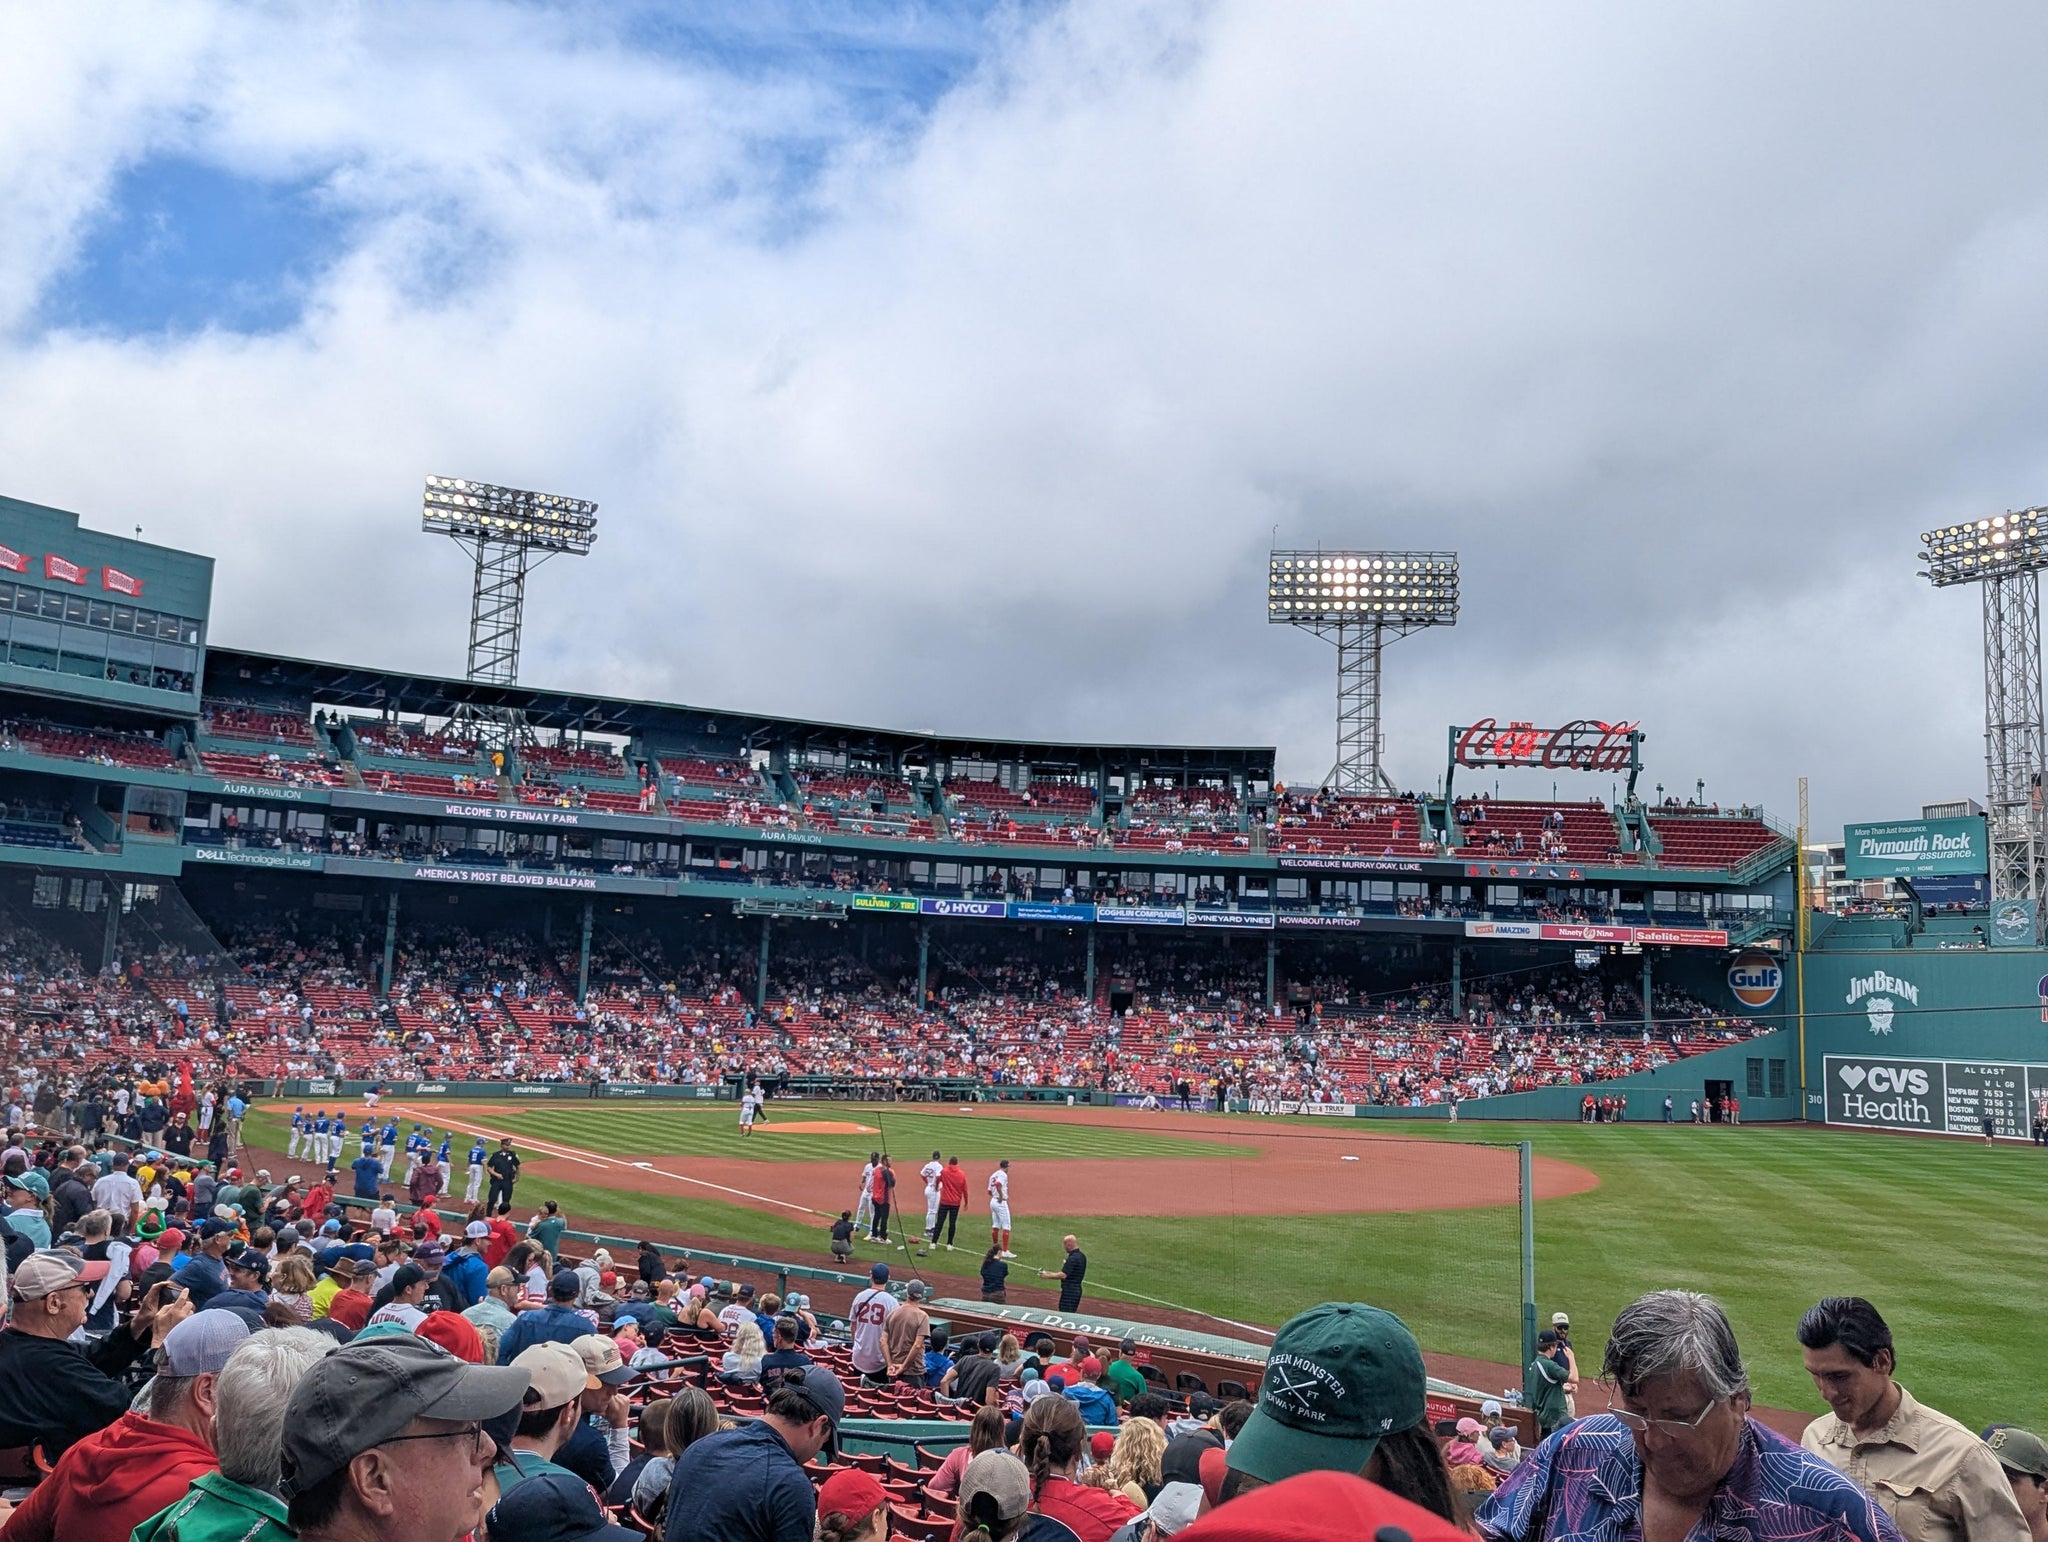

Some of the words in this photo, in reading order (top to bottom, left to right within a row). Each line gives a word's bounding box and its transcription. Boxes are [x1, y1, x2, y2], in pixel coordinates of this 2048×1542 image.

[258, 787, 302, 799] PAVILION
[446, 805, 492, 818] WELCOME
[495, 809, 507, 819] TO
[510, 810, 550, 823] FENWAY
[553, 814, 578, 824] PARK
[1855, 828, 1870, 836] More
[788, 833, 821, 844] PAVILION
[1860, 835, 1929, 856] Plymouth
[1932, 832, 1971, 850] Rock
[196, 850, 226, 860] DELL
[226, 851, 285, 867] Technologies
[287, 855, 311, 867] Level
[1919, 850, 1971, 860] assurance
[415, 868, 468, 881] AMERICA'S
[471, 871, 498, 882] MOST
[501, 873, 544, 886] BELOVED
[546, 876, 596, 889] BALLPARK
[855, 898, 890, 908] SULLIVAN
[901, 902, 915, 910] TIRE
[952, 902, 987, 914] HYCU
[1135, 910, 1183, 918] COMPANIES
[1197, 915, 1242, 923] VINEYARD
[1244, 916, 1271, 924] VINES
[1332, 918, 1360, 926] PITCH?
[1495, 926, 1530, 934] AMAZING
[1558, 928, 1583, 937] Ninety
[1636, 931, 1680, 941] Safelite
[1729, 968, 1777, 987] Gulf
[1874, 970, 1919, 1006] BEAM
[1867, 1066, 1930, 1096] CVS
[513, 1086, 551, 1094] smartwater
[1994, 1090, 2004, 1098] 53
[1808, 1095, 1823, 1105] 310
[1994, 1099, 2004, 1107] 56
[1842, 1093, 1932, 1123] Health
[1948, 1106, 1974, 1114] BOSTON
[1995, 1108, 2004, 1116] 59
[2008, 1109, 2013, 1117] 6
[1949, 1114, 1979, 1123] TORONTO
[2007, 1118, 2015, 1126] 13
[1949, 1123, 1982, 1133] BALTIMORE
[2007, 1128, 2015, 1136] 13
[857, 1302, 886, 1326] 23
[1272, 1375, 1281, 1385] 37
[1293, 1356, 1346, 1399] MONSTER
[1307, 1390, 1319, 1400] FT
[1297, 1406, 1326, 1422] PARK
[1426, 1402, 1455, 1414] AUTION!
